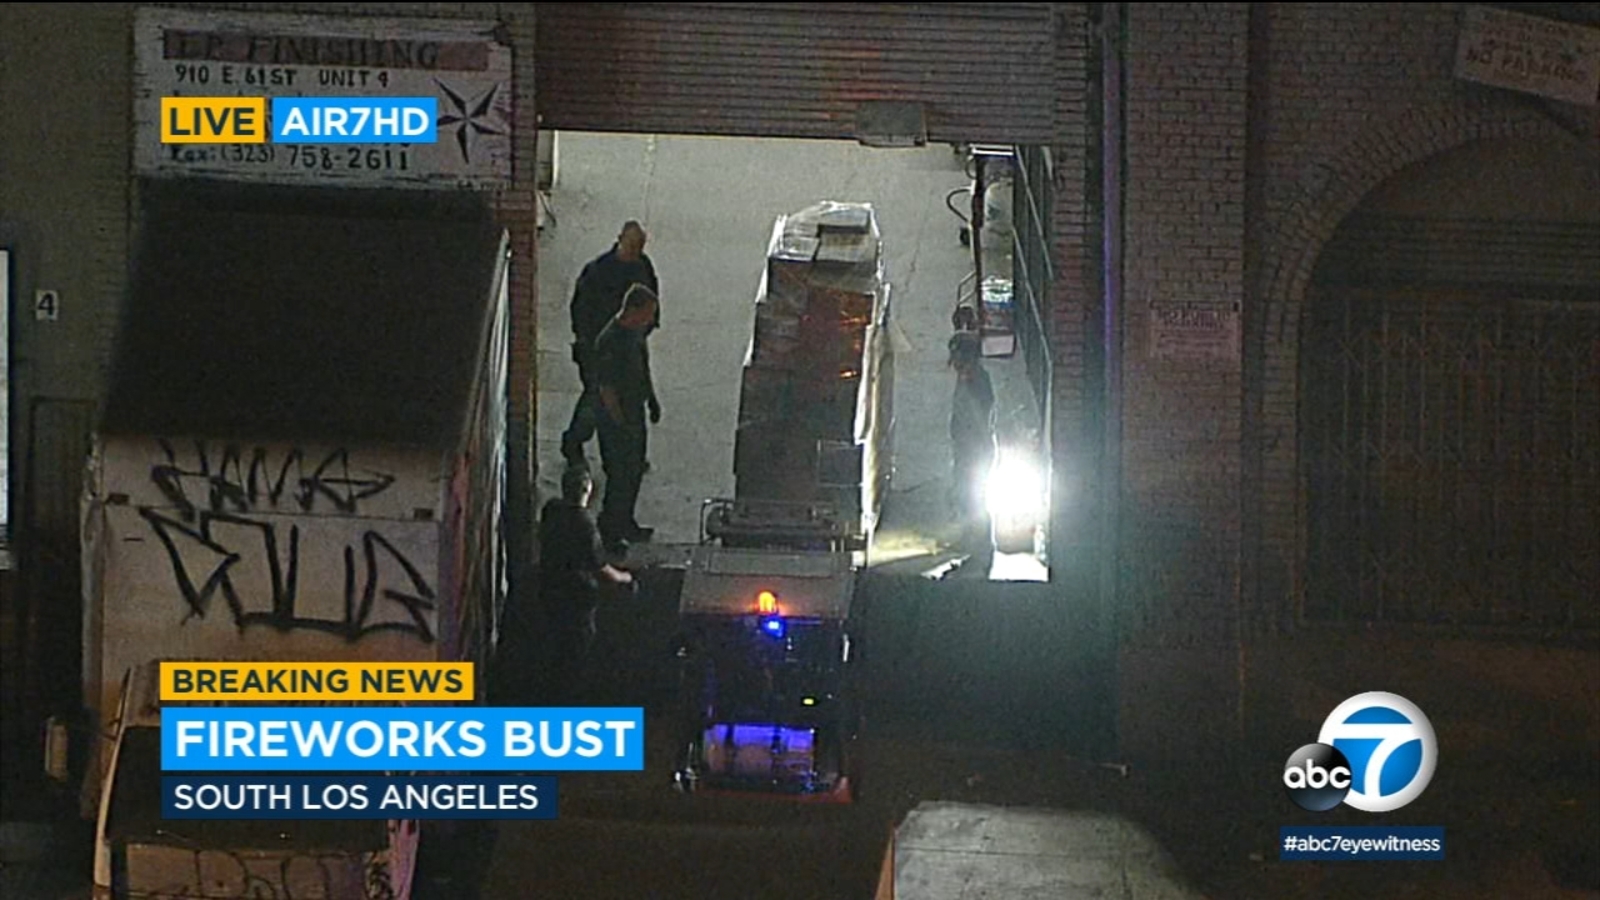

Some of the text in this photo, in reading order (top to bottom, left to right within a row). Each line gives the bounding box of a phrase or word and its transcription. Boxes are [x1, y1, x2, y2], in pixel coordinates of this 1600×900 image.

[174, 64, 209, 84] 910
[245, 67, 297, 87] 61ST
[319, 69, 370, 88] UNIT
[286, 145, 408, 171] 758-2611
[38, 293, 55, 317] 4
